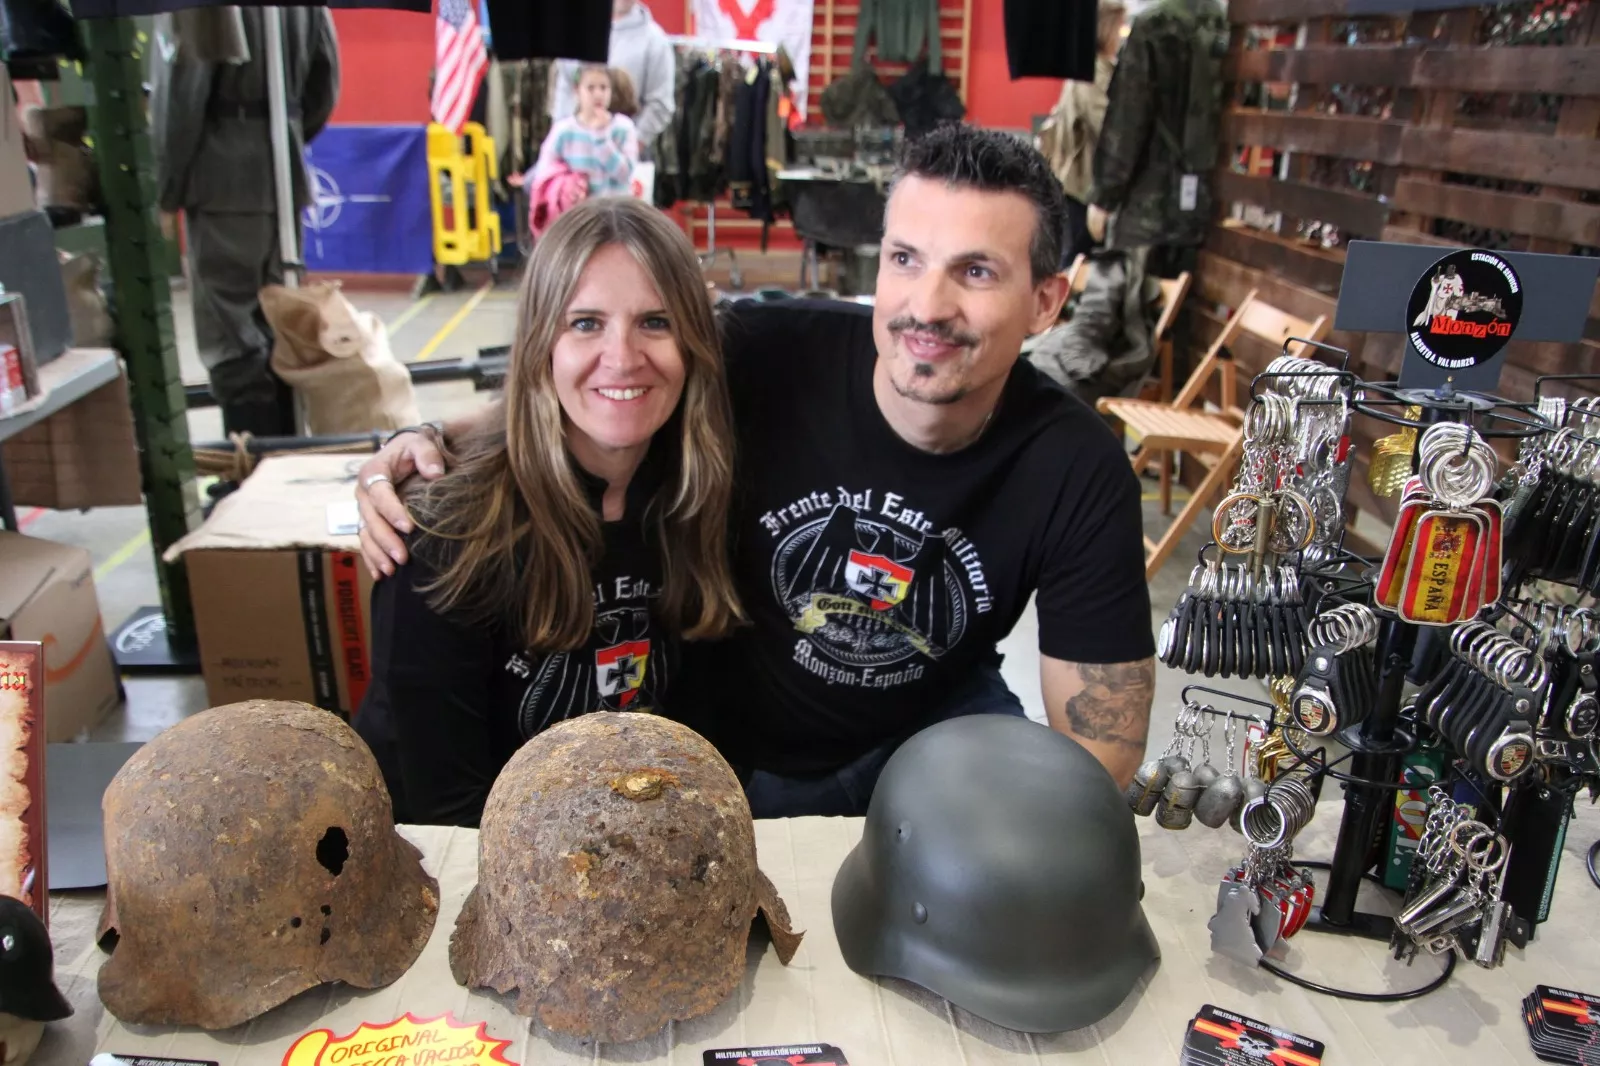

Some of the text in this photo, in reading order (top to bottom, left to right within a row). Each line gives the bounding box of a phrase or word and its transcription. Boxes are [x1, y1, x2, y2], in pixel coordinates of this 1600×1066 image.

[1496, 261, 1506, 271] DE
[1430, 316, 1512, 338] Monzón
[1410, 331, 1433, 359] ALBERTO
[1437, 356, 1450, 367] VAL
[1450, 356, 1475, 368] MARZO
[760, 491, 833, 537] Frente
[837, 486, 873, 513] del
[1424, 562, 1449, 611] ESPAÑA
[1212, 1009, 1242, 1023] MILITARIA
[331, 1029, 448, 1064] ORIGINAL
[715, 1050, 747, 1059] MILITARIA
